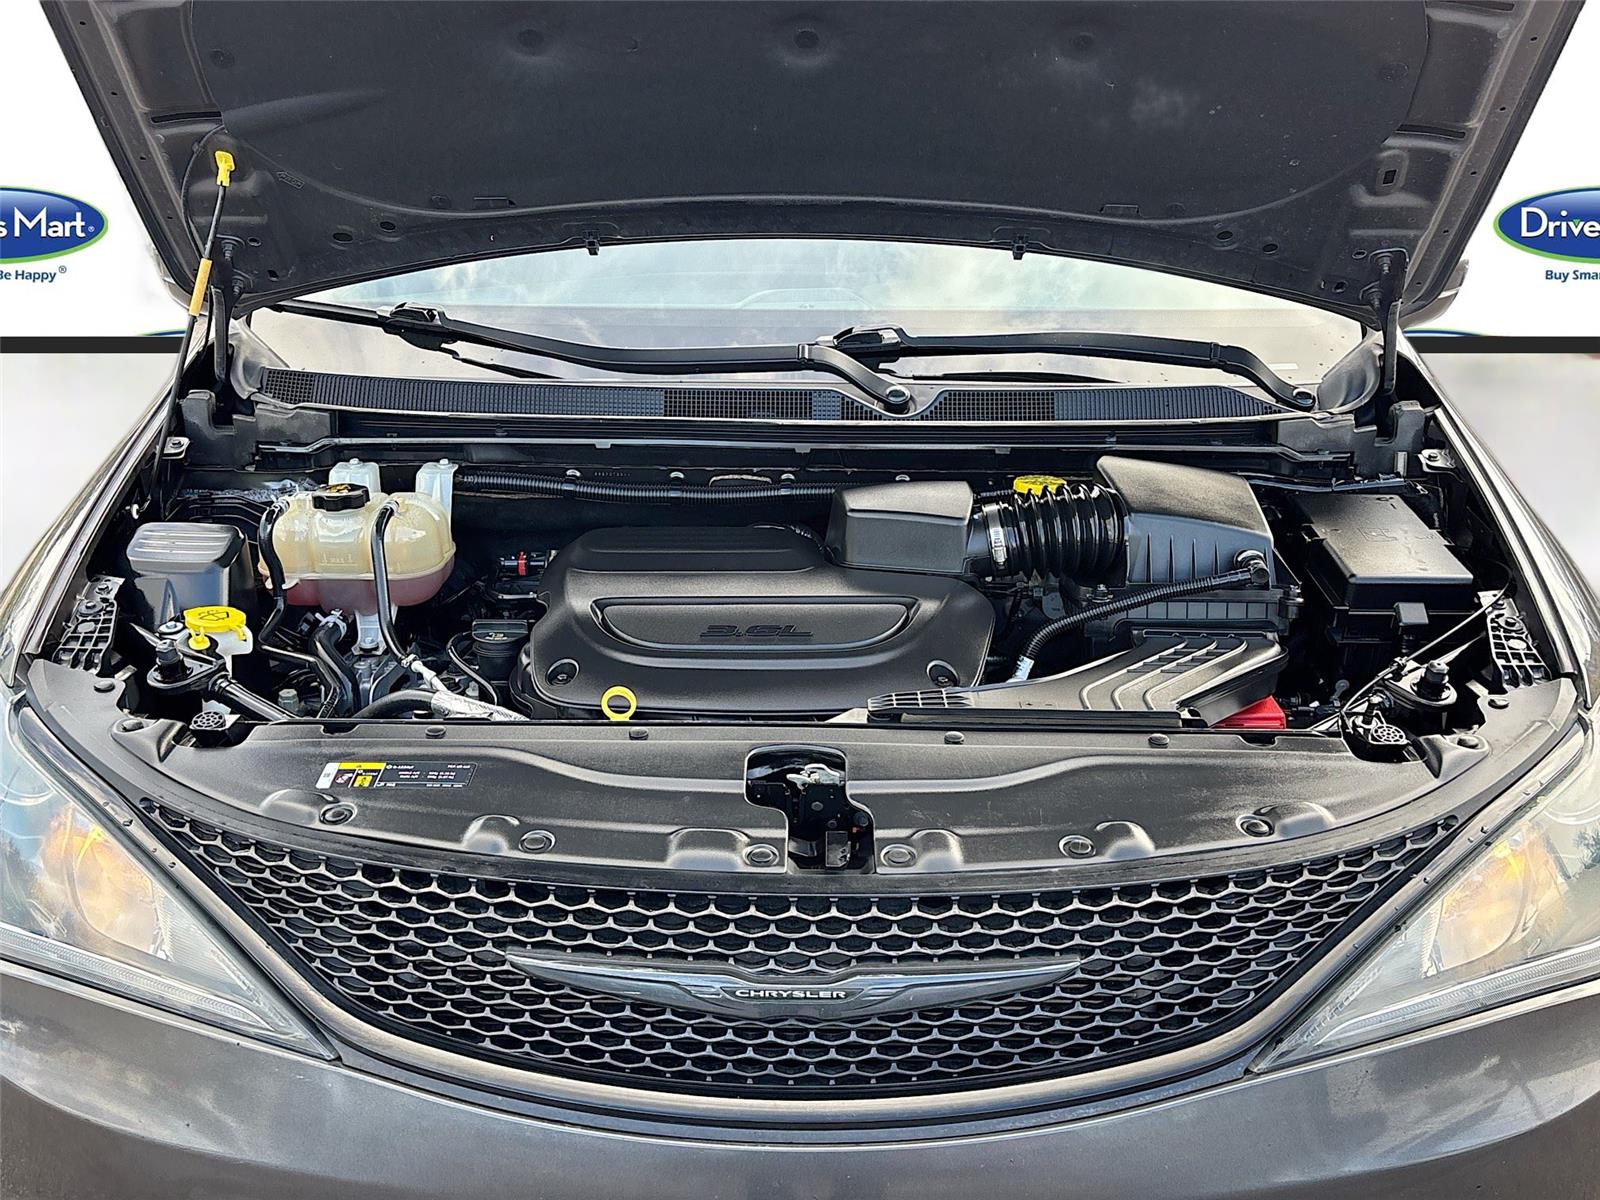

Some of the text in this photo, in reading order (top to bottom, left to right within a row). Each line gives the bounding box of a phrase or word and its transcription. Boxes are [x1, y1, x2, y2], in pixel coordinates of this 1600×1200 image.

[1521, 206, 1600, 237] Drive
[1545, 269, 1600, 283] Buy Sma
[700, 624, 814, 637] 3.6L
[735, 989, 846, 998] CHRYSLER
